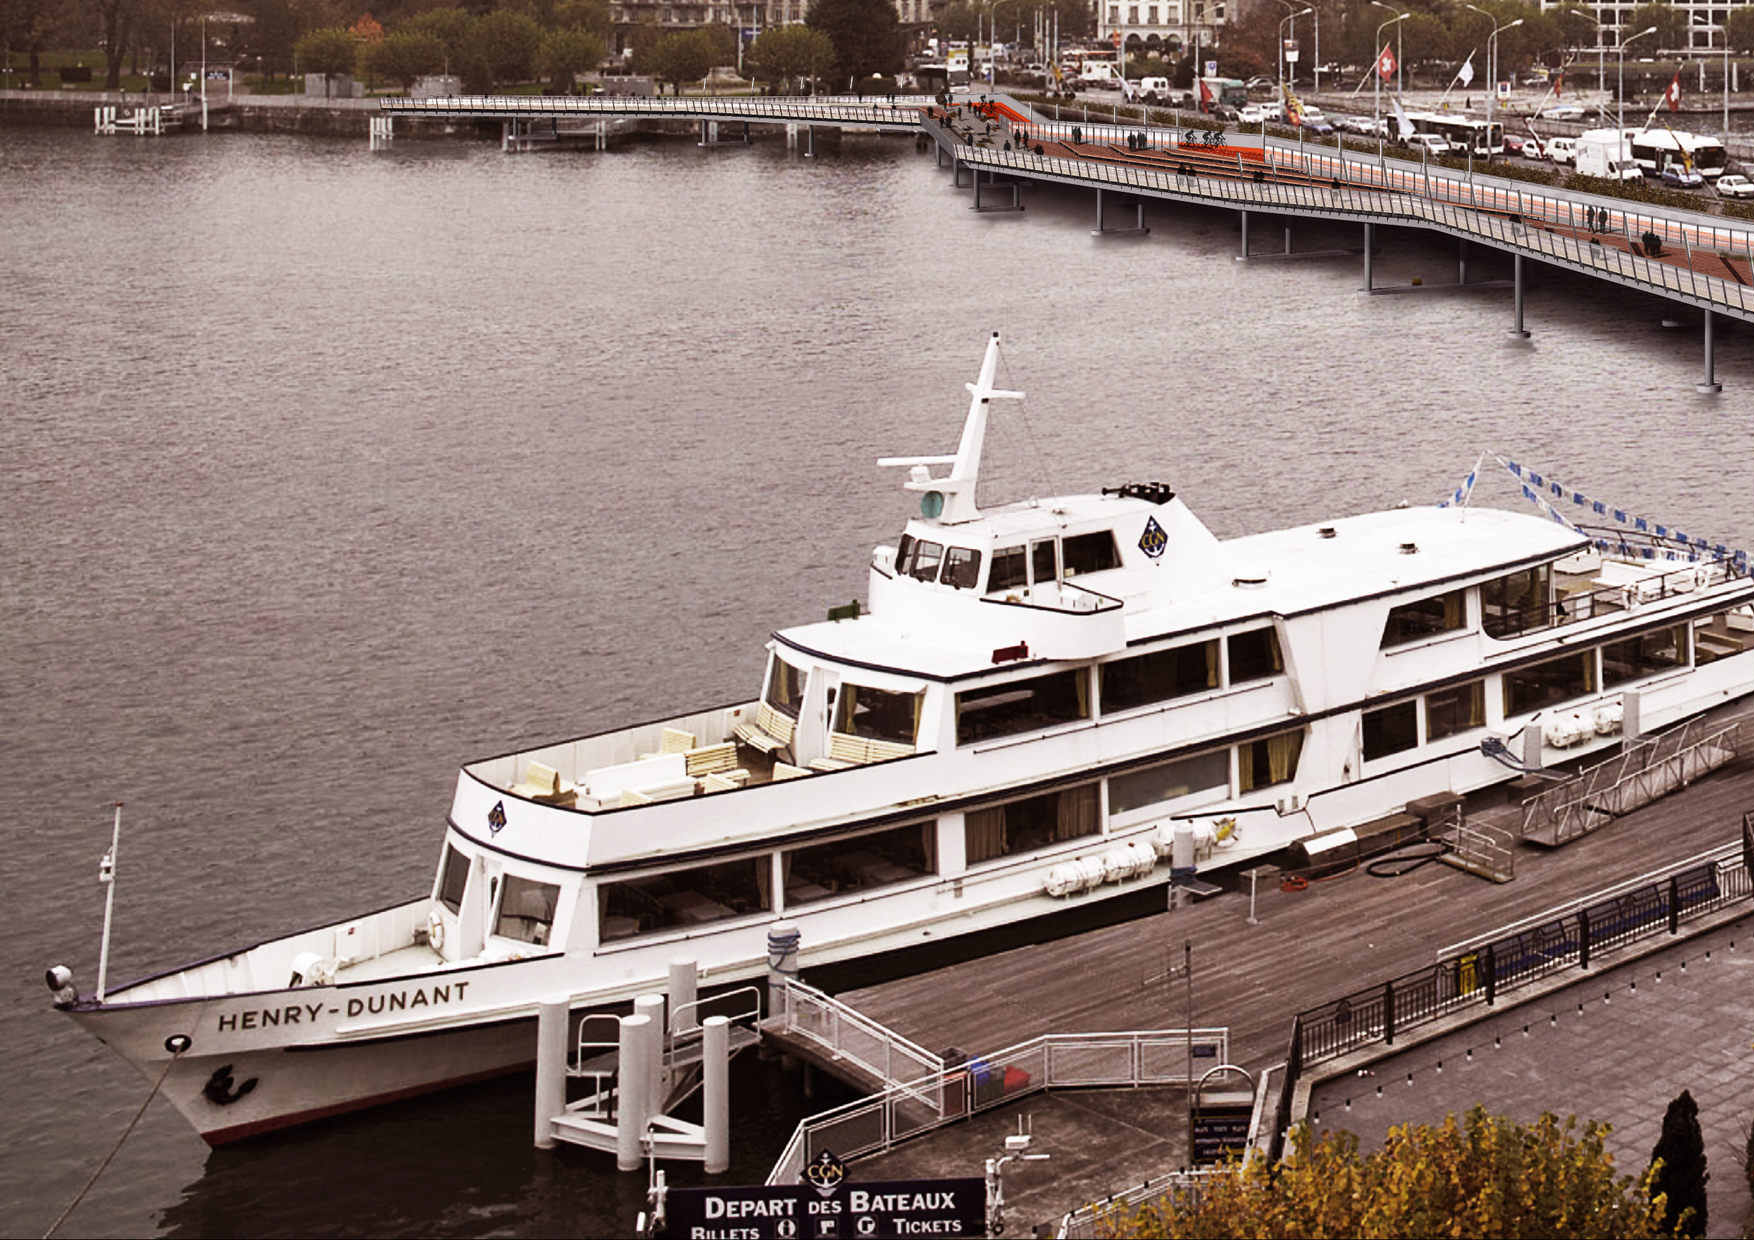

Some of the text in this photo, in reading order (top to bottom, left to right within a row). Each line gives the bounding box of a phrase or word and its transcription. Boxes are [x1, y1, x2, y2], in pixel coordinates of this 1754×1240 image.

[218, 982, 469, 1032] HENRY-DUNANT
[808, 1163, 843, 1179] CGN
[705, 1197, 797, 1218] DEPART
[850, 1191, 956, 1213] BATEAUX
[690, 1218, 962, 1239] BILLETS TICKETS
